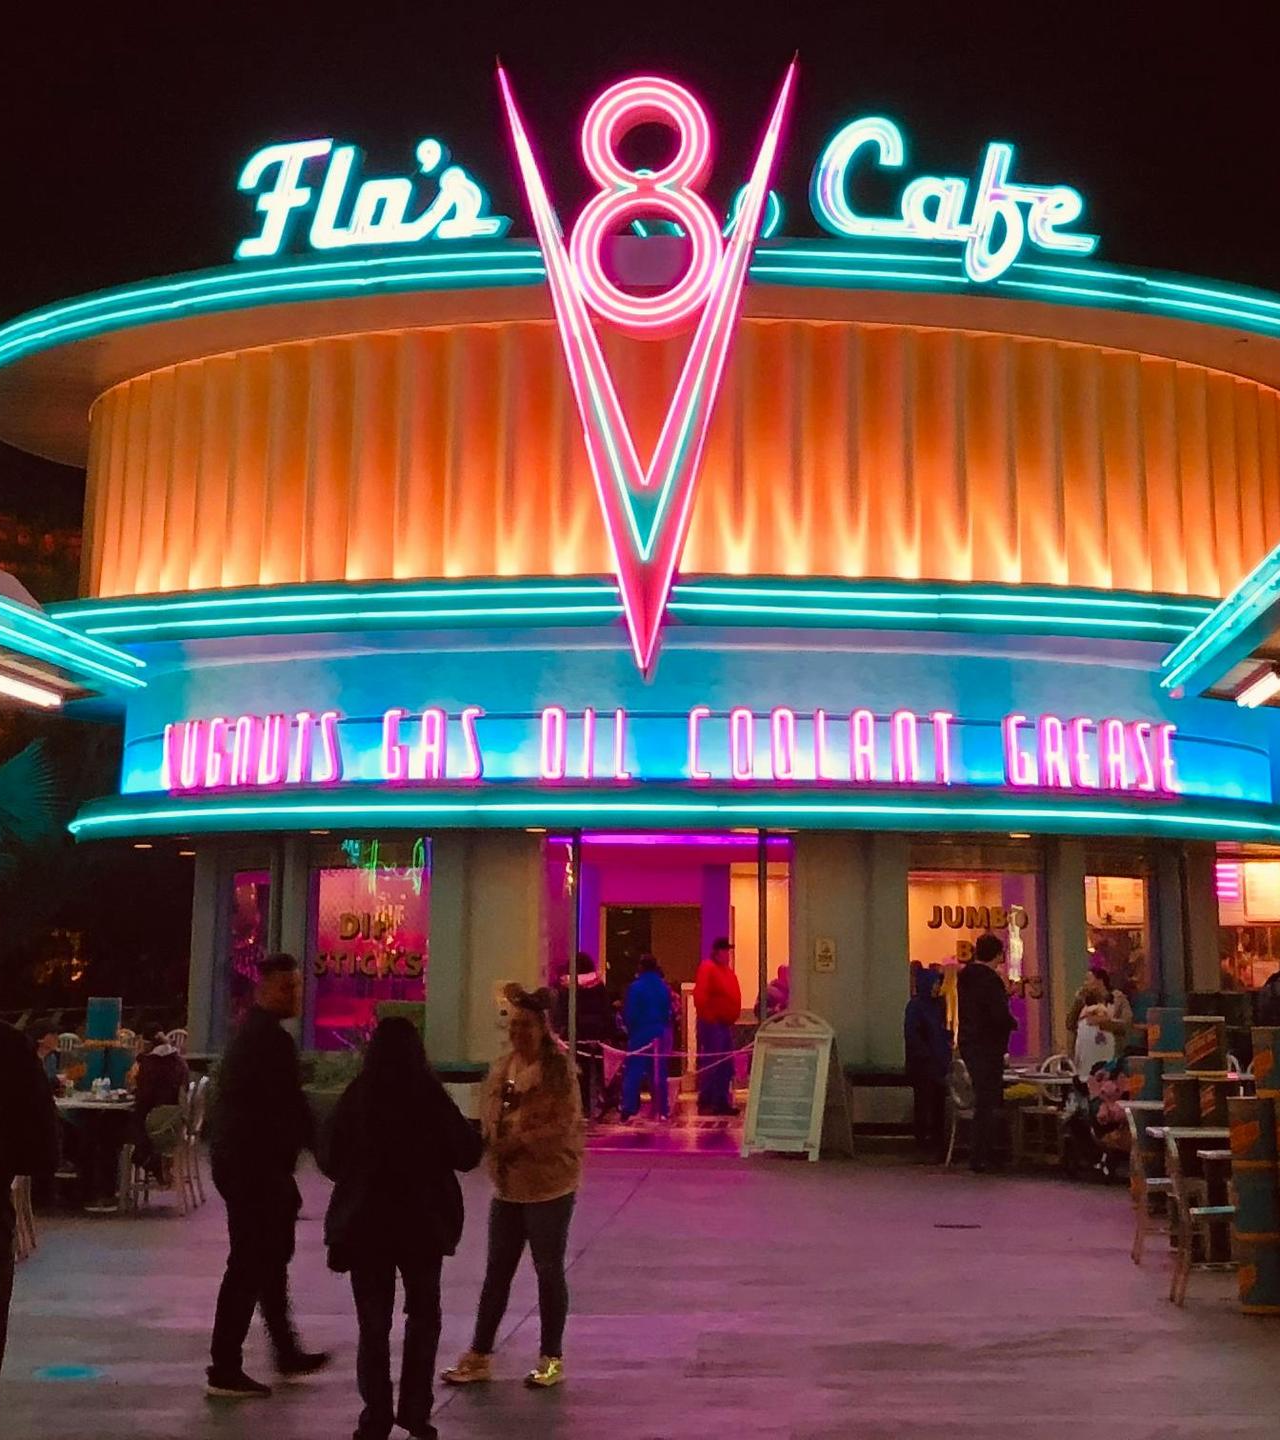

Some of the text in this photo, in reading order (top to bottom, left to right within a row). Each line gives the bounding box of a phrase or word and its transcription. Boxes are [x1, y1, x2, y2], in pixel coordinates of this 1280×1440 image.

[235, 137, 512, 260] Flo's
[809, 116, 1100, 284] Cafe
[381, 707, 484, 782] GAS
[540, 706, 631, 781] OIL
[688, 706, 953, 786] COOLANT
[1003, 713, 1183, 796] GREASE
[927, 905, 1029, 929] JUMBO
